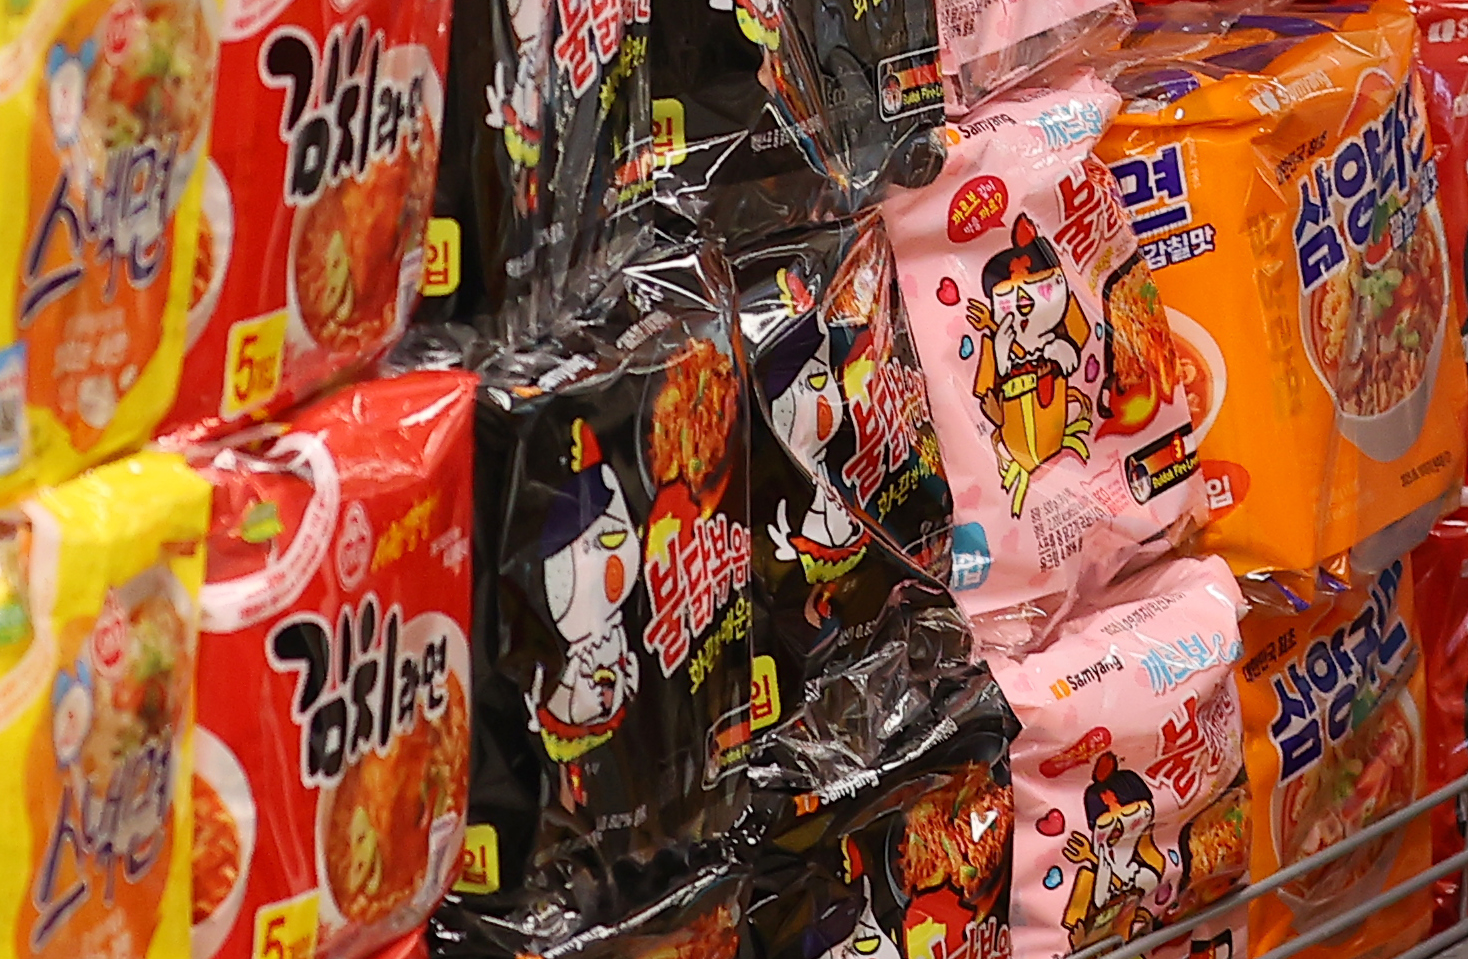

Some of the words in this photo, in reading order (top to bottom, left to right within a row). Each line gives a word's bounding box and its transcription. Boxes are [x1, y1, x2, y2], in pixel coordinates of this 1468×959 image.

[957, 113, 1017, 139] Samyang
[1107, 141, 1194, 241] 면
[1142, 224, 1217, 272] 감칠맛
[1204, 474, 1235, 511] 입
[1066, 653, 1124, 691] Samyang
[820, 769, 880, 806] Samyang
